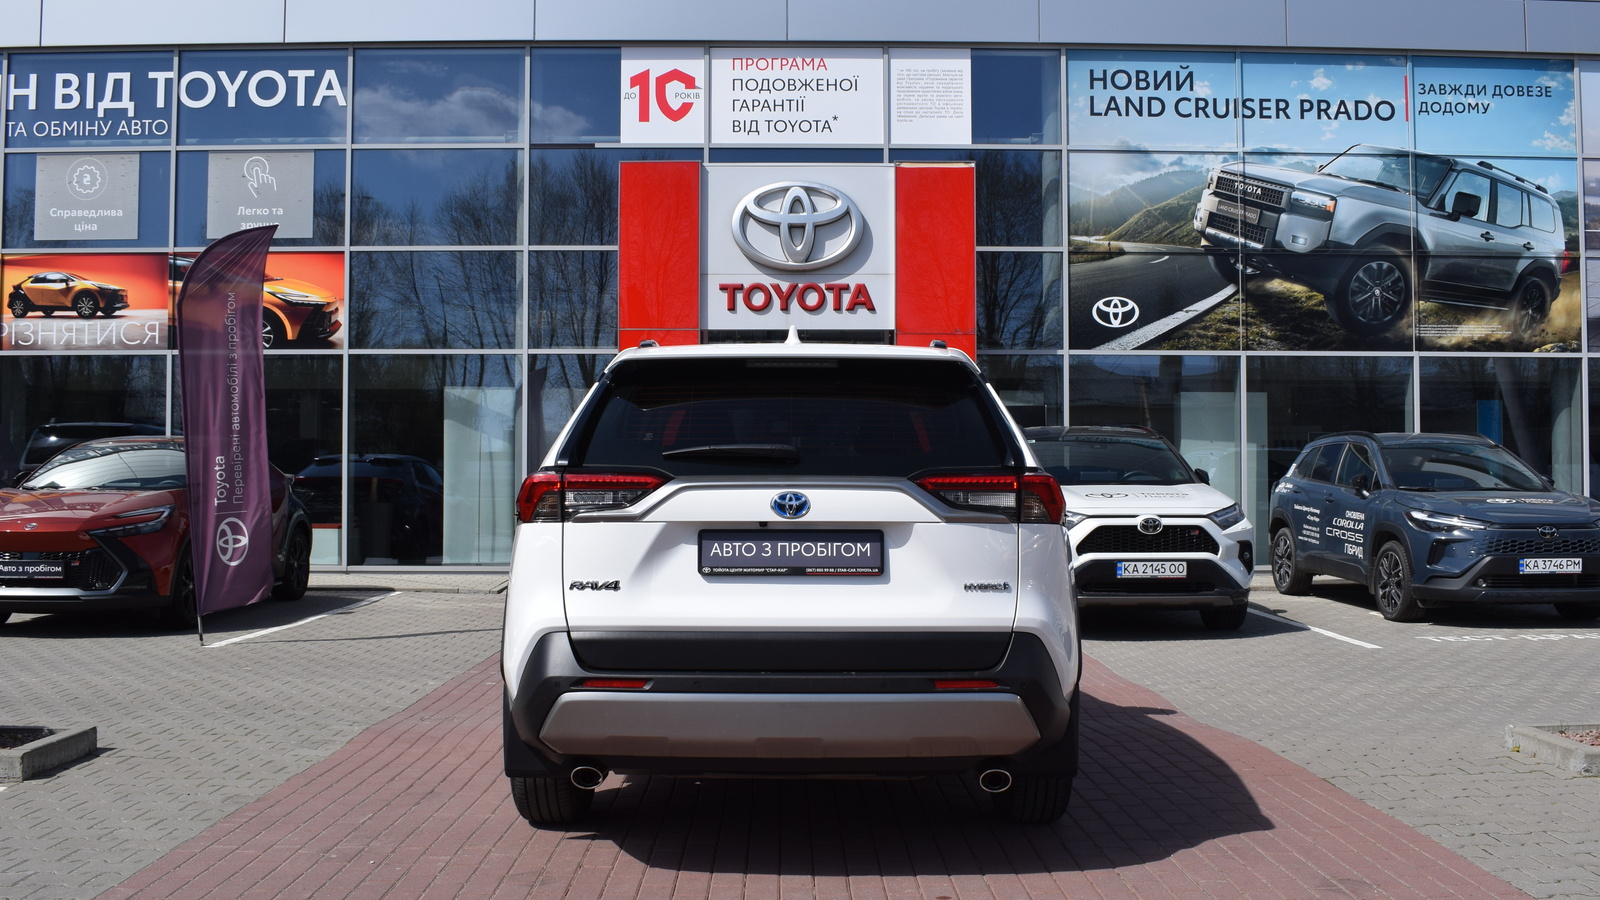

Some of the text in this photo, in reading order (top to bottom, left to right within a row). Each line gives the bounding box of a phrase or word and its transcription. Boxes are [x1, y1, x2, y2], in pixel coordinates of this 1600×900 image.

[732, 57, 828, 71] ПРОГРАМА
[732, 75, 860, 94] ПОДОВЖЕНОЇ
[1089, 65, 1194, 92] НОВИЙ
[55, 72, 135, 117] ВІД
[148, 69, 347, 108] TOYOTA
[623, 92, 637, 100] ДО
[674, 92, 701, 100] РОКІВ
[1418, 83, 1552, 99] ЗАВЖДИ ДОВЕЗЕ
[732, 95, 806, 112] ГАРАНТІЇ
[1090, 95, 1396, 122] LAND CRUISER PRADO
[1418, 101, 1490, 116] ДОДОМУ
[6, 119, 169, 137] ТА ОБМІНУ АВТО
[732, 119, 760, 135] ВІД
[49, 207, 123, 219] Справедлива
[237, 206, 284, 216] Легко та
[74, 221, 98, 232] ціна
[718, 282, 877, 313] TOYOTA
[225, 291, 239, 350] пробігом
[227, 363, 240, 431] автомобілі
[230, 434, 244, 504] Перевірені
[214, 455, 229, 507] Toyota
[1332, 517, 1365, 531] COROLLA
[1325, 526, 1364, 543] CROSS
[710, 542, 871, 557] АВТО З ПРОБІГОМ
[1344, 543, 1364, 559] ГІБРИД
[0, 564, 16, 573] Авто
[24, 563, 62, 574] пробігом
[1123, 563, 1139, 574] KA
[1142, 563, 1166, 574] 2145
[1525, 559, 1581, 570] KA 3746 PM
[569, 580, 620, 592] RAV4
